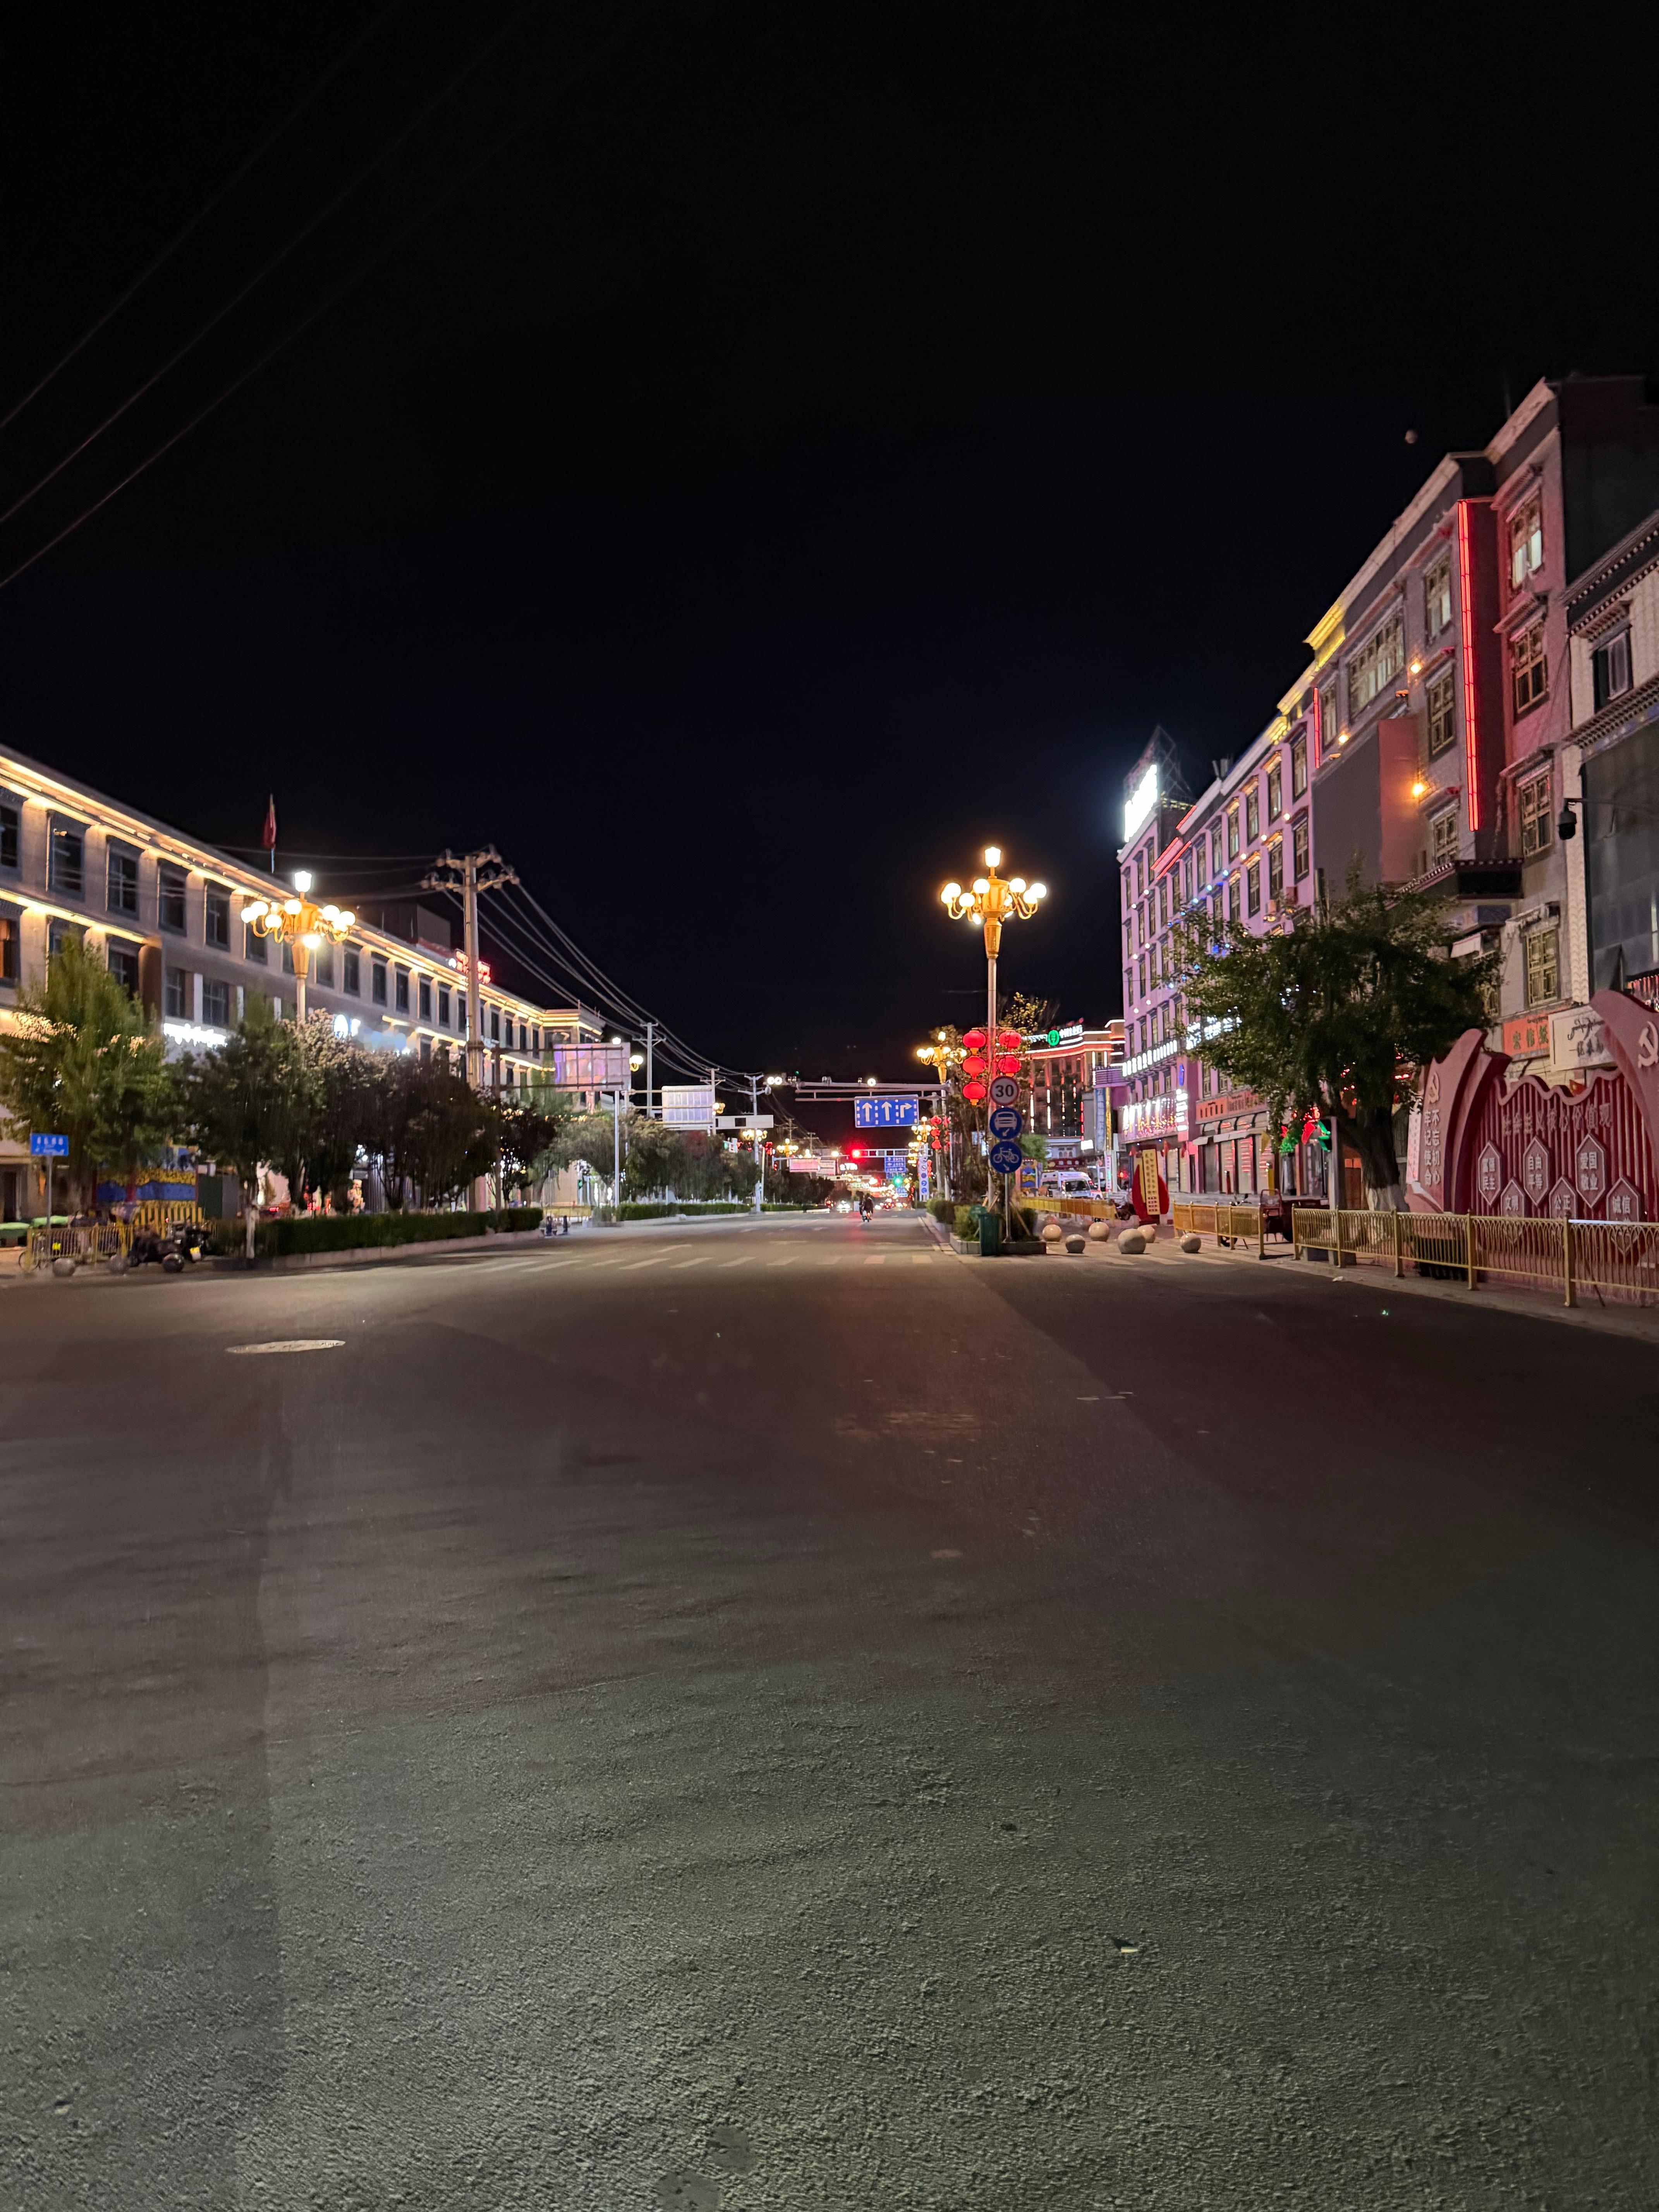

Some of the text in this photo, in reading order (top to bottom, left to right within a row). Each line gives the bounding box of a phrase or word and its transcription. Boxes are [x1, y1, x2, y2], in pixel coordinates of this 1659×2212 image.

[996, 1084, 1014, 1097] 30
[1528, 1154, 1542, 1170] 自由
[1580, 1151, 1597, 1170] 爱国
[1483, 1175, 1496, 1190] 民主
[1528, 1173, 1542, 1190] 平等
[1580, 1173, 1598, 1190] 敬业
[1505, 1195, 1518, 1211] 文明
[1554, 1194, 1571, 1210] 公正
[1613, 1195, 1631, 1214] 诚信
